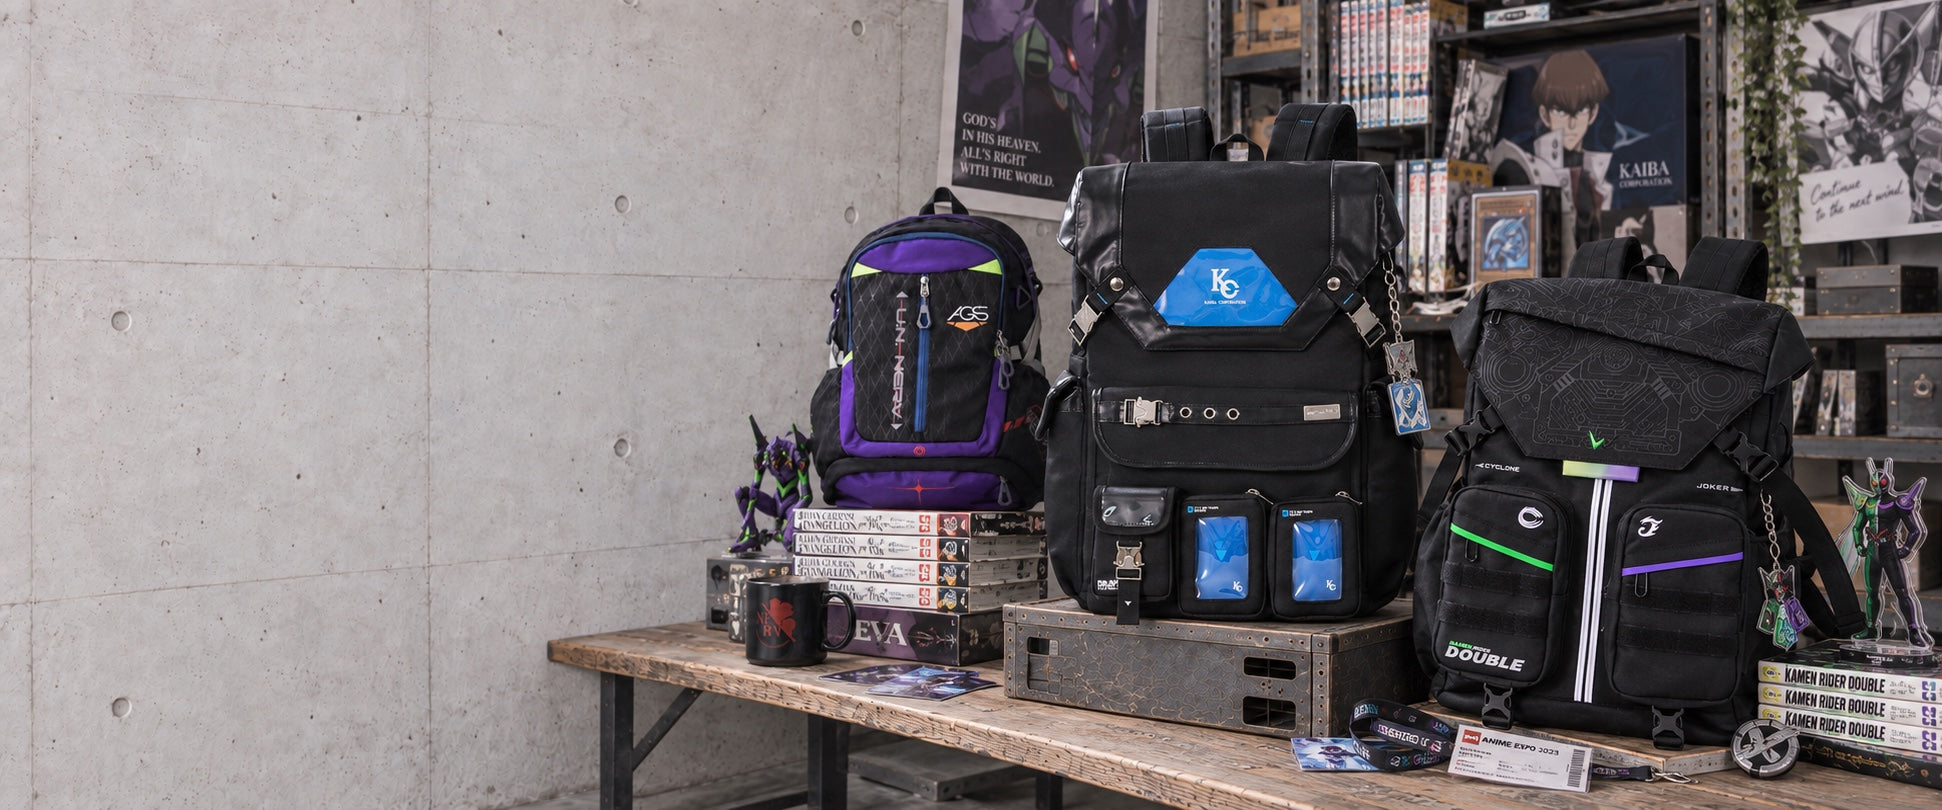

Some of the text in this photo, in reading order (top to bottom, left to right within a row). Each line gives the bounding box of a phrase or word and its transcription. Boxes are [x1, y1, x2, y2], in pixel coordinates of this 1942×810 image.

[962, 112, 997, 129] GOD'S
[962, 128, 1041, 154] IN HIS HEAVEN.
[961, 146, 1027, 167] ALL'S RIGHT
[1619, 160, 1670, 179] KAIBA
[960, 162, 1055, 188] WITH THE WORLD.
[1811, 180, 1861, 206] Continue
[1815, 208, 1826, 222] to
[1829, 199, 1844, 217] the
[1849, 190, 1873, 209] next
[947, 306, 989, 321] AGS
[891, 355, 905, 419] NERV
[1484, 463, 1520, 473] CYCLONE
[1696, 483, 1730, 492] JOKER
[855, 619, 908, 647] EVA
[1445, 645, 1525, 672] DOUBLE
[1785, 666, 1817, 685] KAMEN
[1819, 671, 1846, 689] RIDER
[1848, 676, 1885, 694] DOUBLE
[1785, 690, 1817, 708] KAMEN
[1819, 694, 1846, 711] RIDER
[1848, 698, 1885, 717] DOUBLE
[1785, 711, 1817, 730] KAMEN
[1819, 717, 1846, 734] RIDER
[1848, 721, 1885, 741] DOUBLE
[1482, 736, 1513, 748] ANIME
[1514, 742, 1536, 752] EXPO
